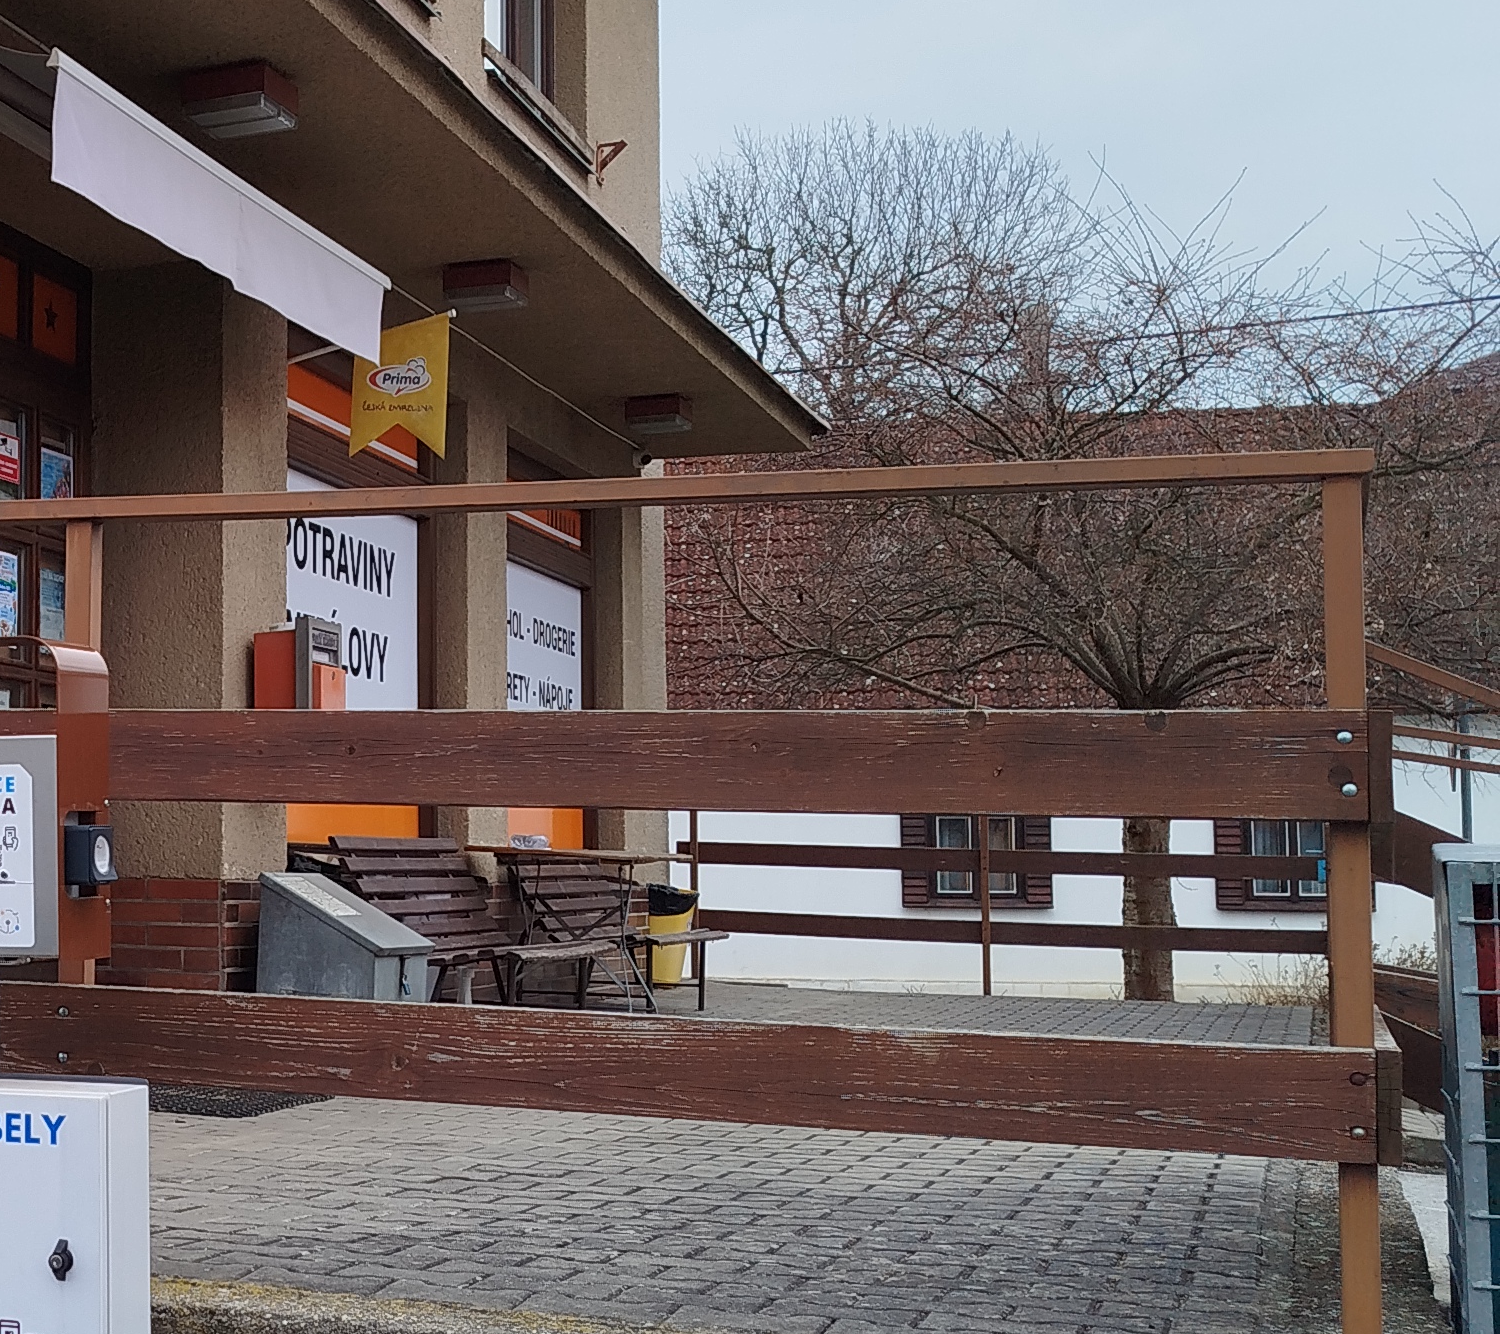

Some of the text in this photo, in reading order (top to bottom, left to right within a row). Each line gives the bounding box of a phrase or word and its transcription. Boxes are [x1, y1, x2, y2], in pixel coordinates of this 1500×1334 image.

[382, 373, 421, 385] Prima
[286, 517, 395, 598] OTRAVINY
[533, 618, 576, 657] DROGERIE
